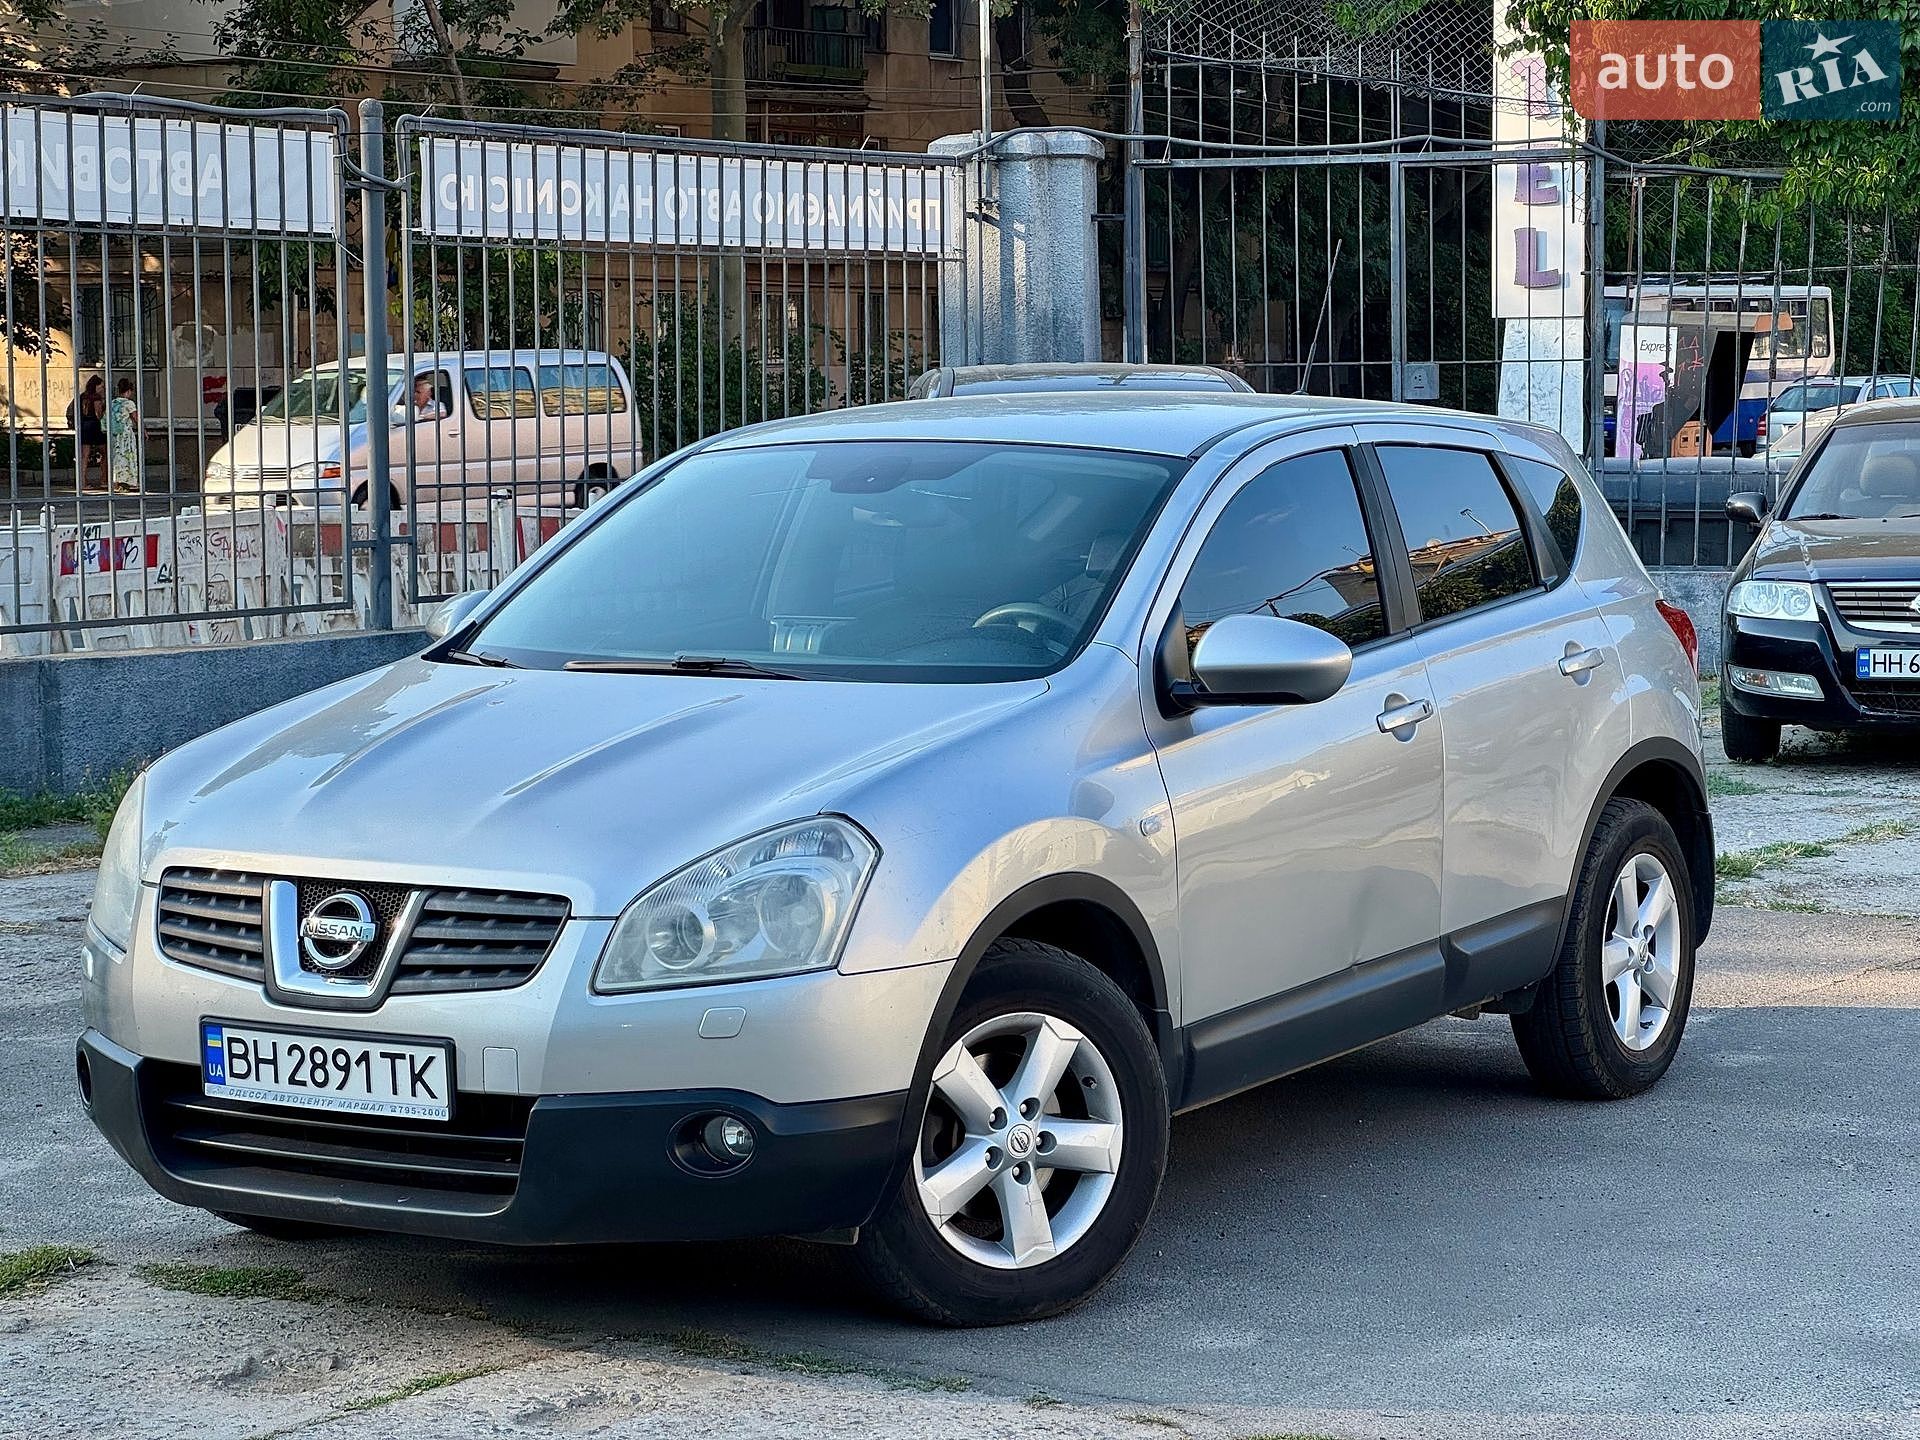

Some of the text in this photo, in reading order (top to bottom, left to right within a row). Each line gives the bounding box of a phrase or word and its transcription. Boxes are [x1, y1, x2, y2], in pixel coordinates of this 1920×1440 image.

[1873, 653, 1902, 673] HH
[304, 919, 363, 938] NISSAN
[208, 1063, 224, 1078] UA
[227, 1036, 438, 1100] BH 2891 TK
[228, 1088, 268, 1101] ОДЕССА
[272, 1093, 335, 1108] АВТОЦЕНТР
[337, 1101, 384, 1112] МАРШАЛ
